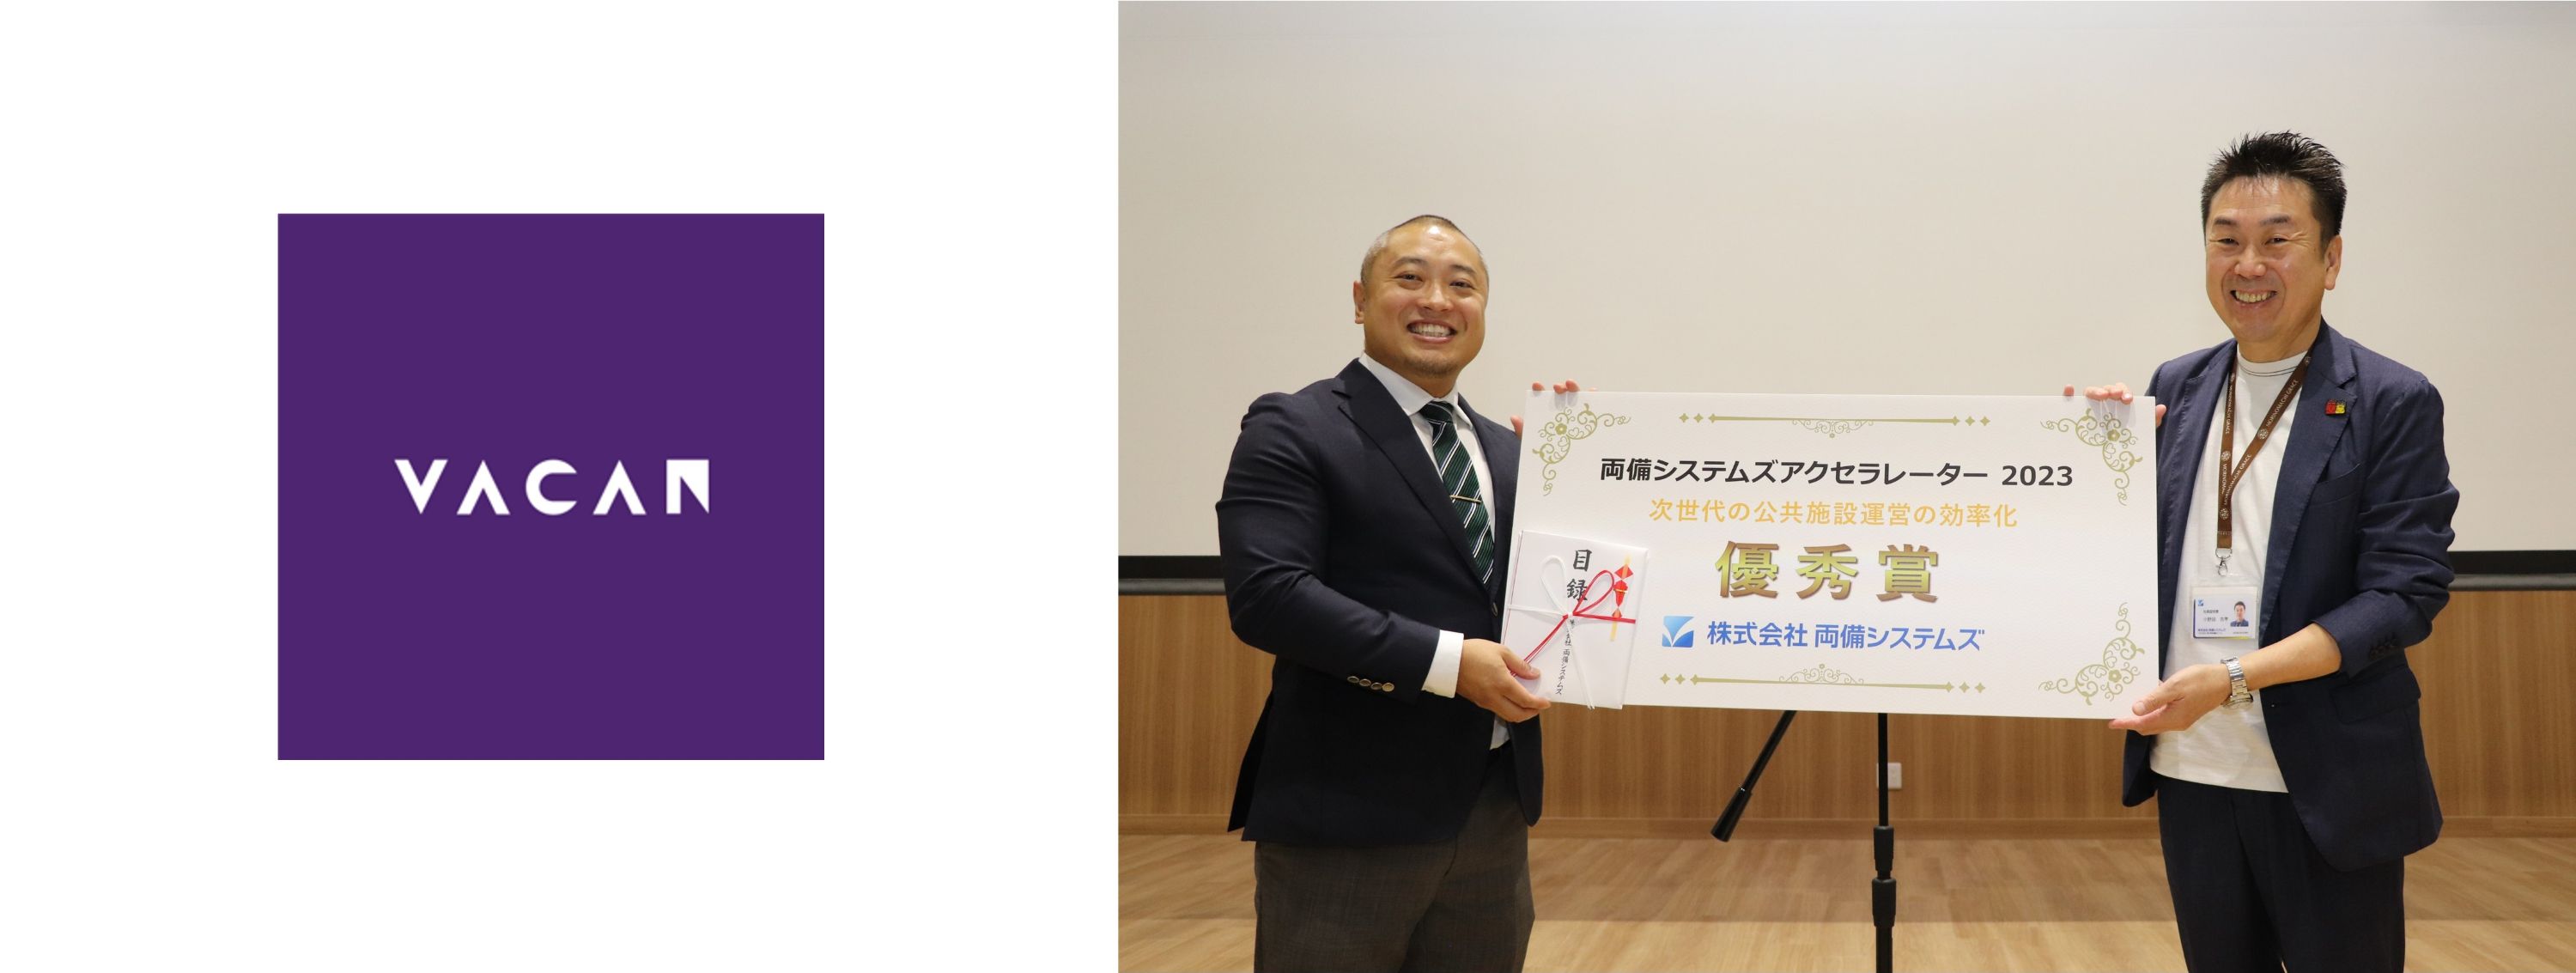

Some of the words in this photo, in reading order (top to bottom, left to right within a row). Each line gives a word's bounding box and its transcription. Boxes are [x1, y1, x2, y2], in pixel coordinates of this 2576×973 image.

[2286, 379, 2300, 395] GRACE
[1601, 458, 1989, 486] 両備システムズアクセラレーター
[2002, 465, 2074, 487] 2023
[1649, 498, 2018, 528] 次世代の公共施設運営の効率化
[1566, 549, 1593, 601] 目録
[1715, 540, 1940, 603] 優秀賞
[1707, 620, 1808, 647] 株式会社
[1814, 623, 1986, 651] 両備システムズ
